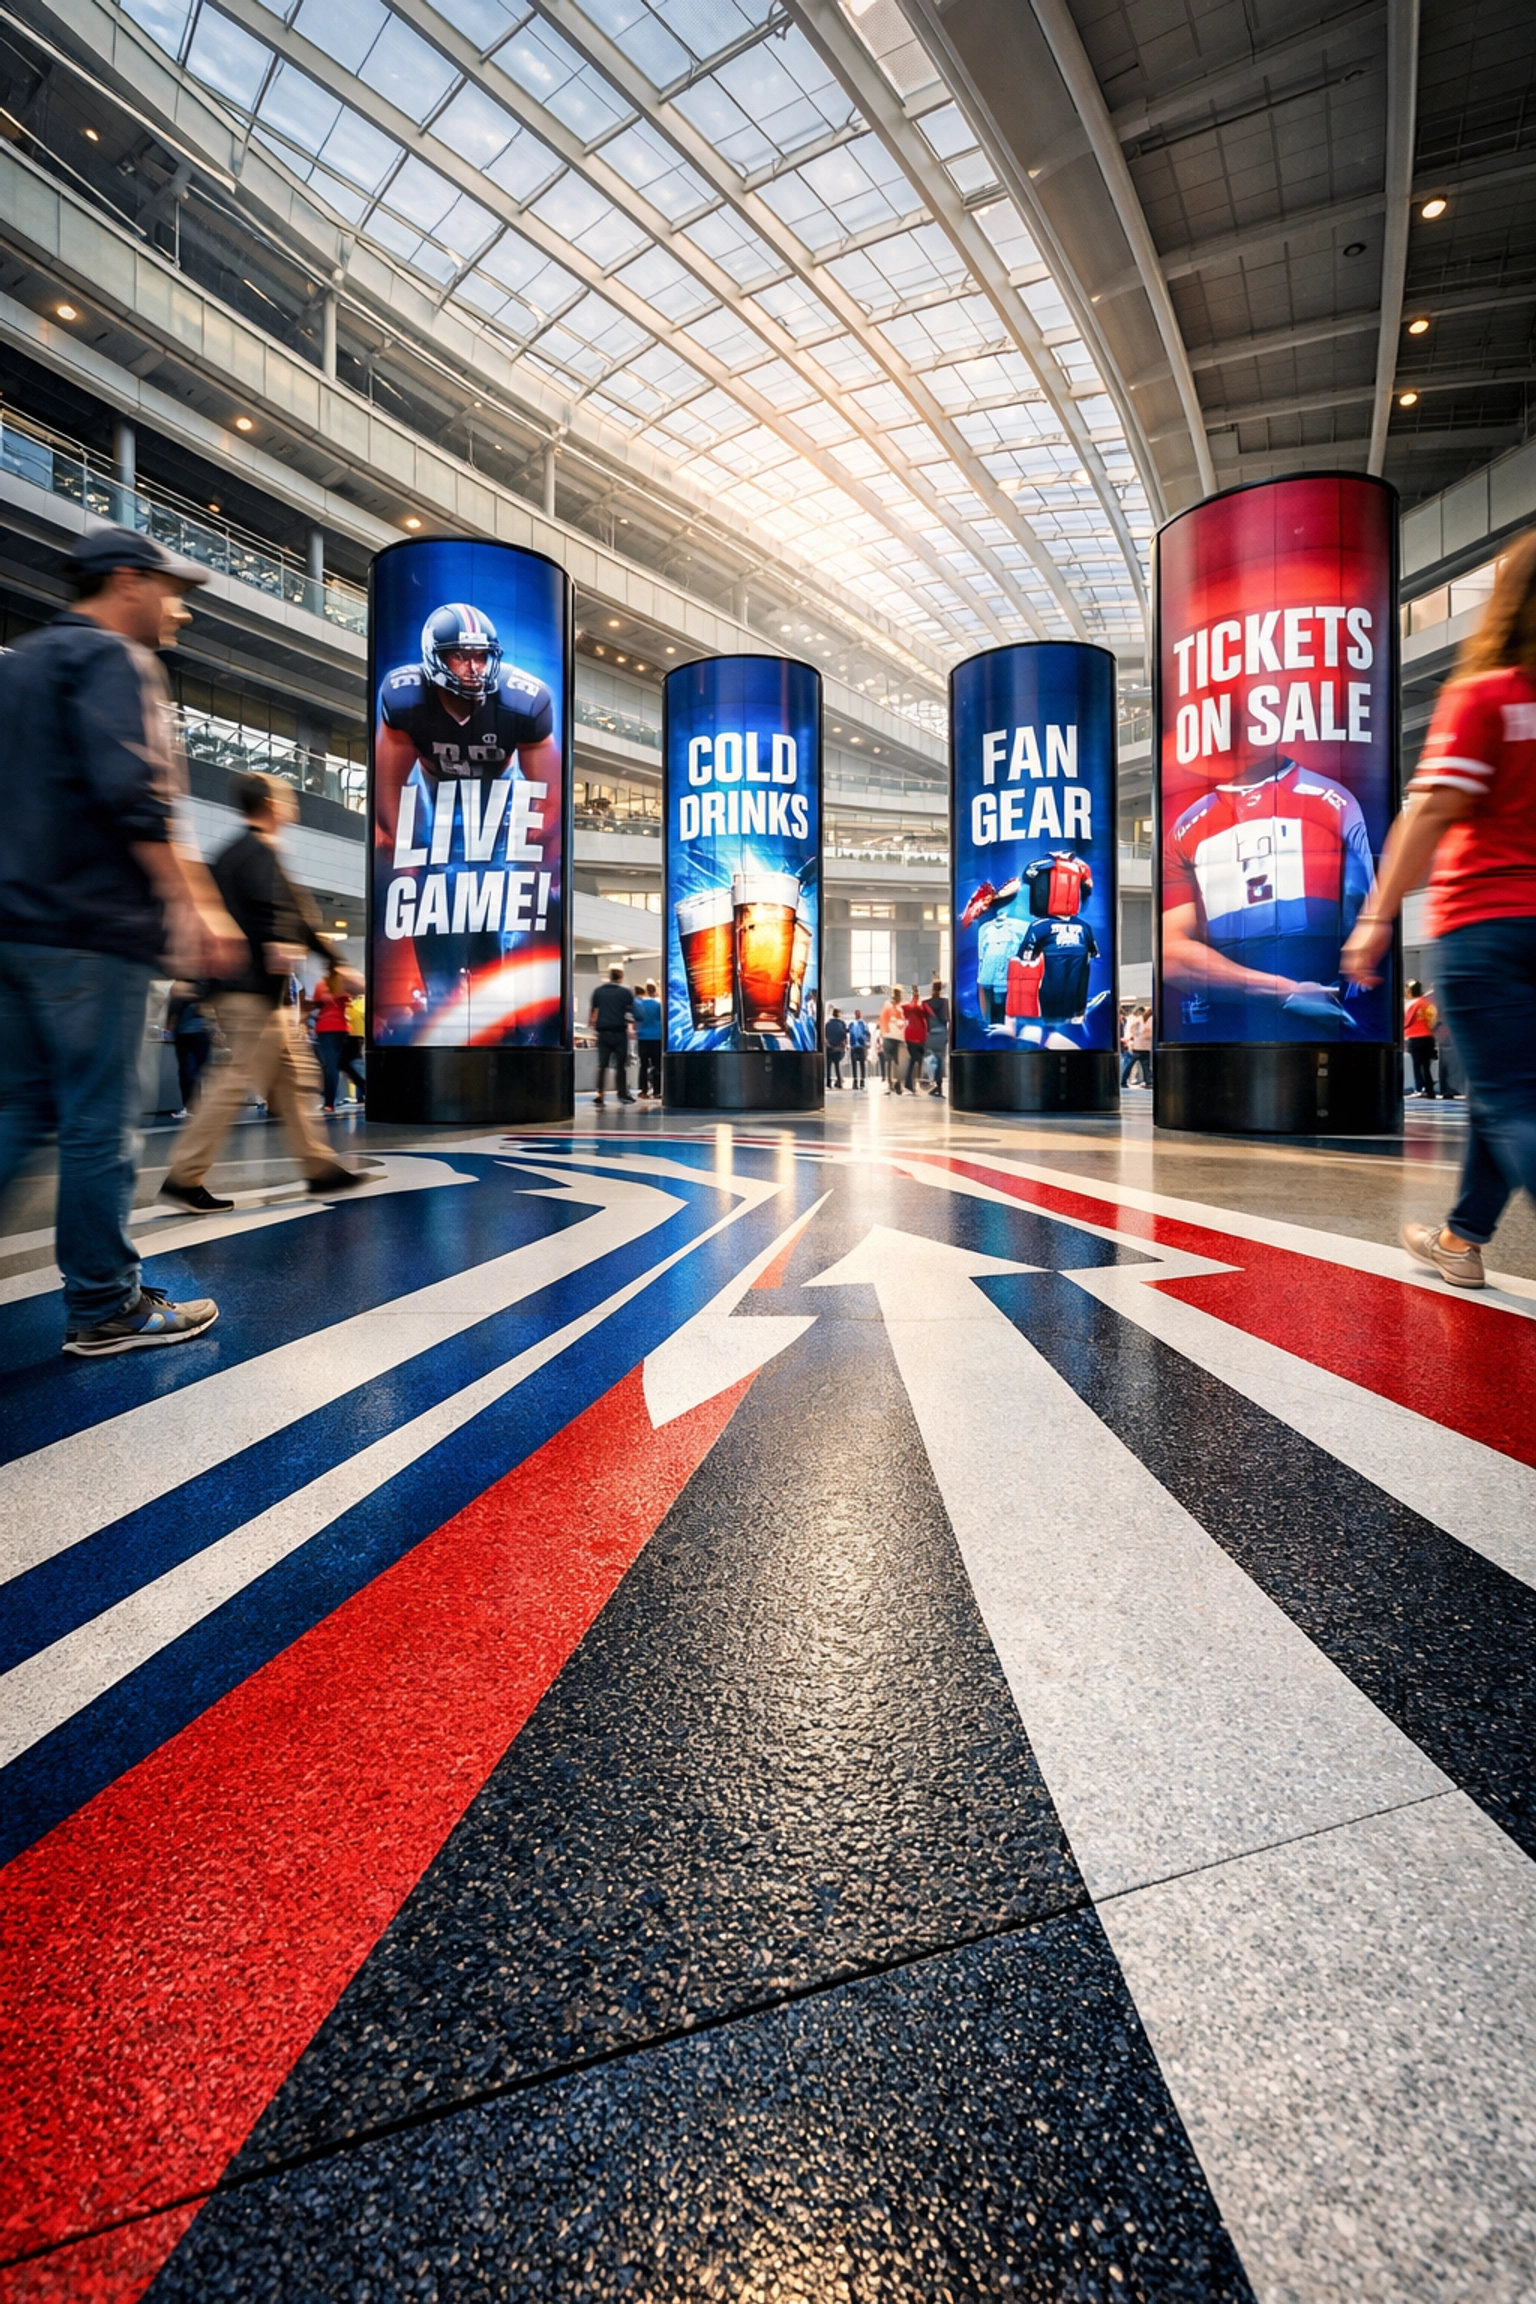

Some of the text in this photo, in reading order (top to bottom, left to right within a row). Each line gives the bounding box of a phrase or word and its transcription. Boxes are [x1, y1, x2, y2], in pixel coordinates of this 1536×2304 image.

[1173, 606, 1374, 697] TICKETS
[982, 724, 1078, 786] FAN
[1176, 681, 1372, 765] ON SALE
[688, 731, 797, 787] COLD
[393, 779, 548, 869] LIVE
[679, 790, 808, 842] DRINKS
[971, 786, 1092, 846] GEAR
[384, 871, 552, 941] GAME!
